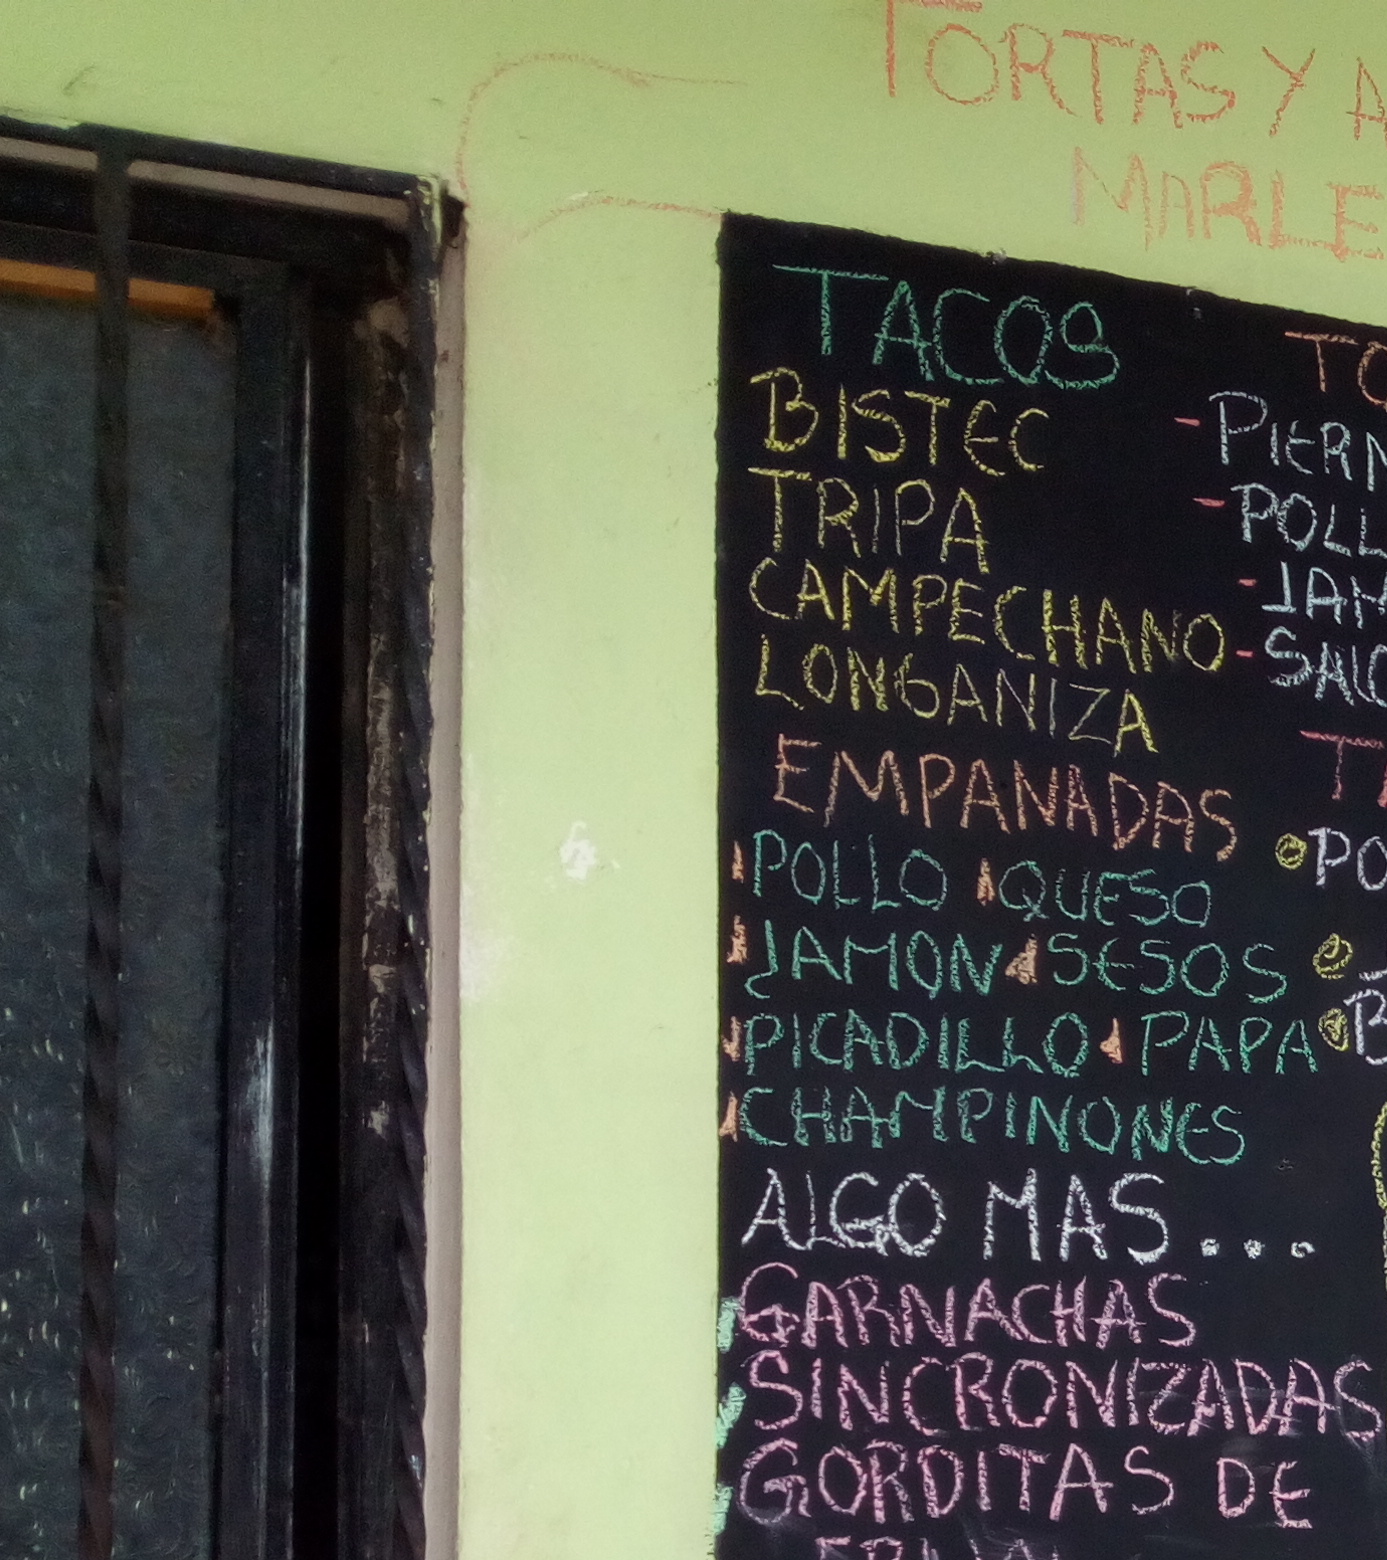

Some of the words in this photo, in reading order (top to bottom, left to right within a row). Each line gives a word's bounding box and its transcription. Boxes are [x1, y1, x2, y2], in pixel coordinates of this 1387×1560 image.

[886, 0, 1236, 128] TORTAS
[1261, 46, 1316, 138] Y
[772, 264, 1121, 390] TACOS
[749, 367, 1050, 477] BISTEC
[747, 466, 990, 574] TRIPA
[749, 556, 1226, 675] CAMPECHANO
[754, 632, 1159, 757] LONGANIZA
[773, 733, 1238, 862] EMPANADAS
[752, 829, 948, 911] POLLO
[999, 859, 1212, 928] QUESO
[744, 919, 1003, 999] JAMON
[1045, 933, 1288, 1004] SESOS
[744, 1008, 1091, 1078] PICADILLO
[1141, 1009, 1318, 1076] PAPA
[739, 1086, 1245, 1166] CHAMPINONES
[741, 1167, 948, 1257] ALGO
[739, 1261, 1197, 1348] GARNACHAS
[742, 1350, 1384, 1441] SINCRONIZADAS
[738, 1438, 1176, 1524] GORDITAS
[1217, 1457, 1313, 1530] DE
